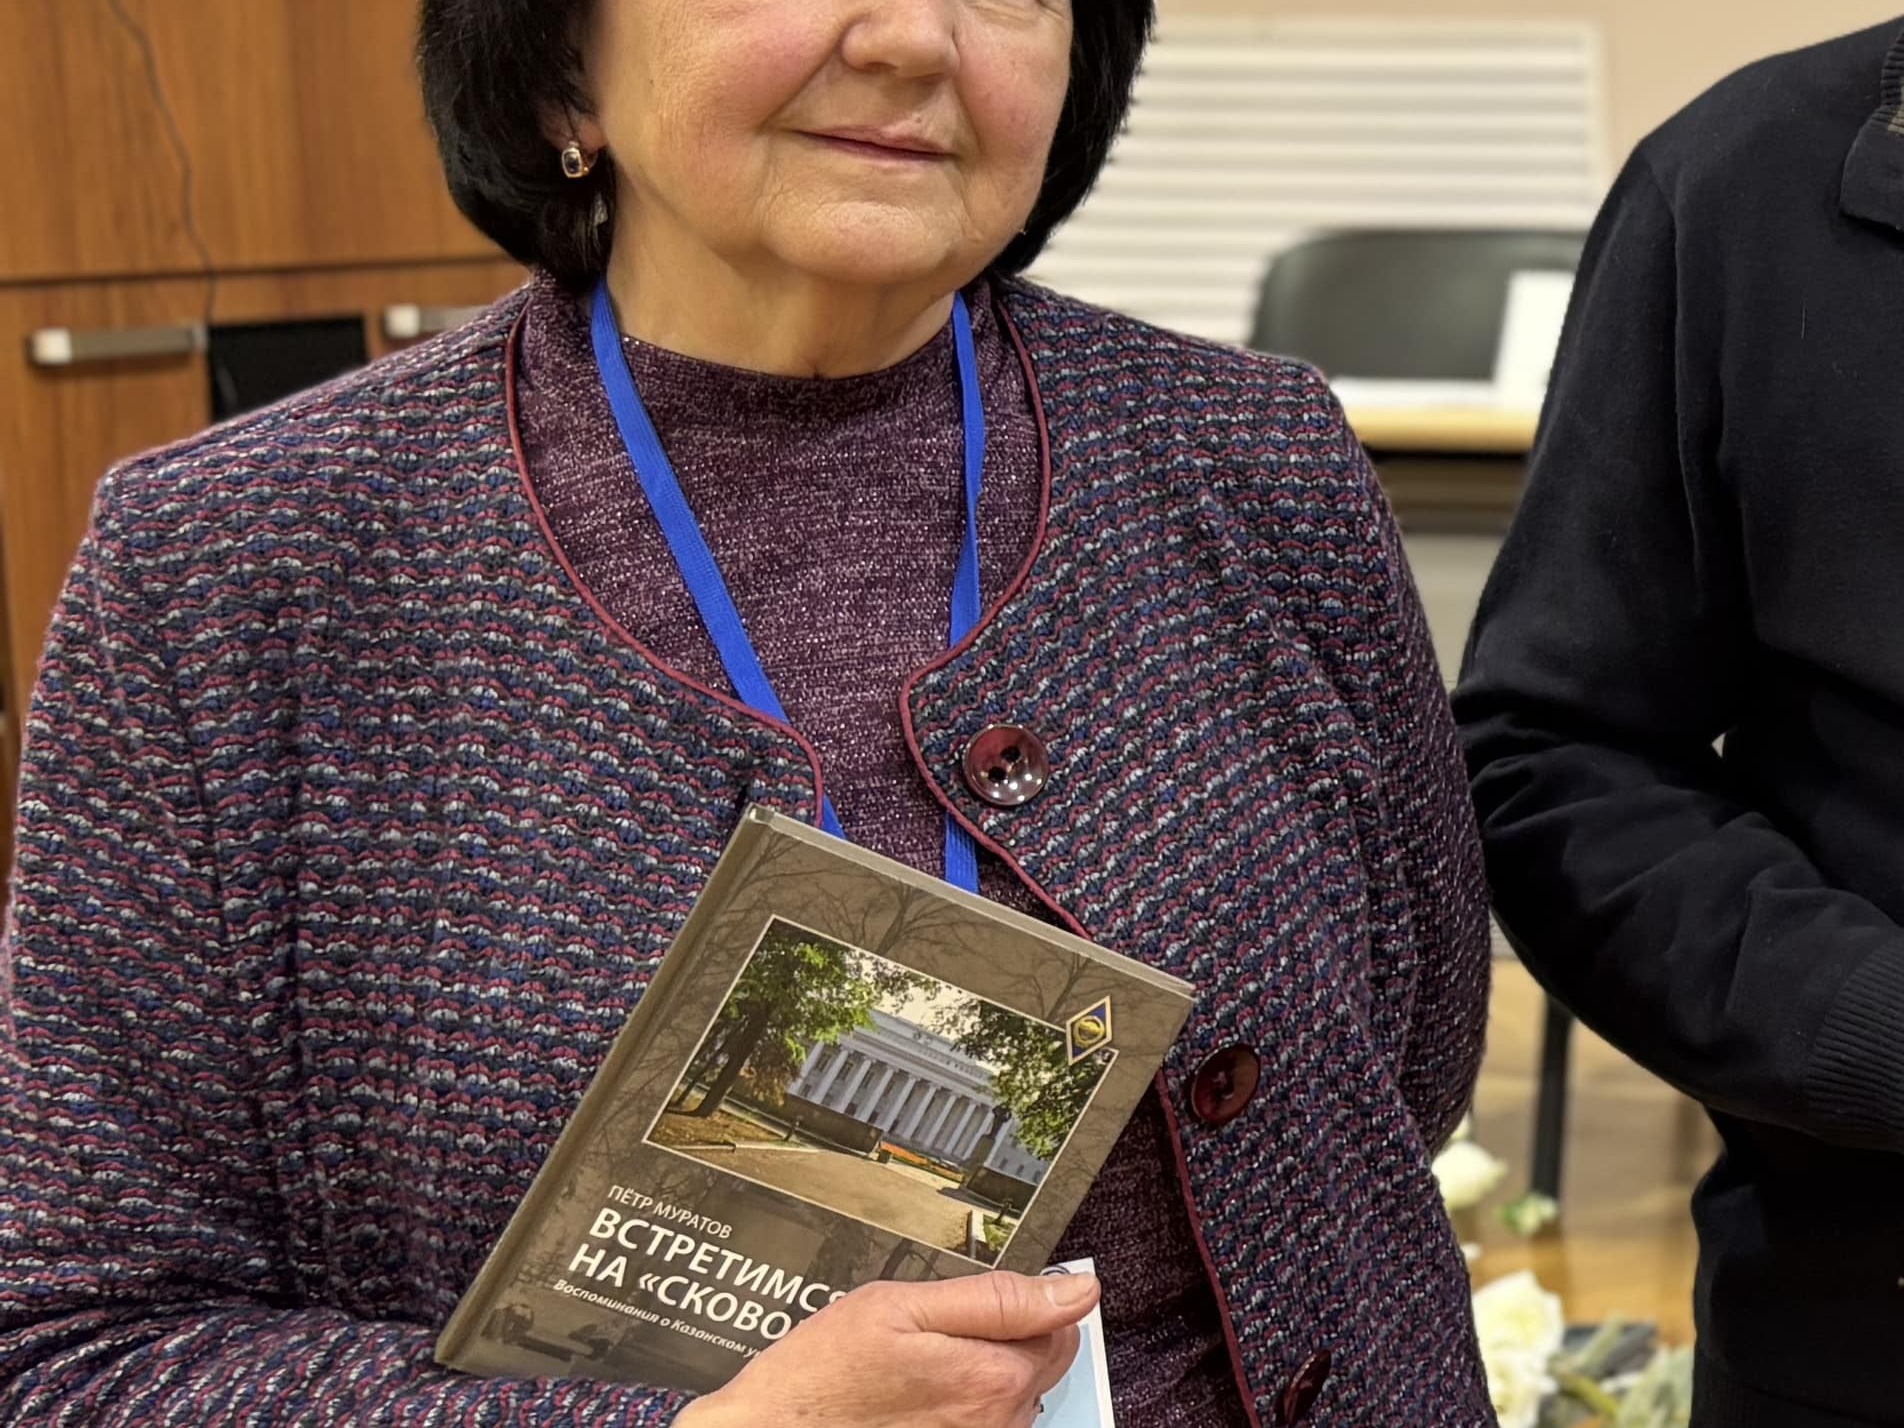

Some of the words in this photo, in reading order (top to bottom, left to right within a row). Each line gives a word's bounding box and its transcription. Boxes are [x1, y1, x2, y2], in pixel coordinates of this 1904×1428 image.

[607, 1184, 653, 1209] ПЁТР
[653, 1201, 733, 1239] МУРАТОВ
[568, 1243, 628, 1288] НА
[553, 1279, 660, 1323] Воспоминания
[660, 1317, 671, 1326] о
[670, 1319, 747, 1354] Казанском
